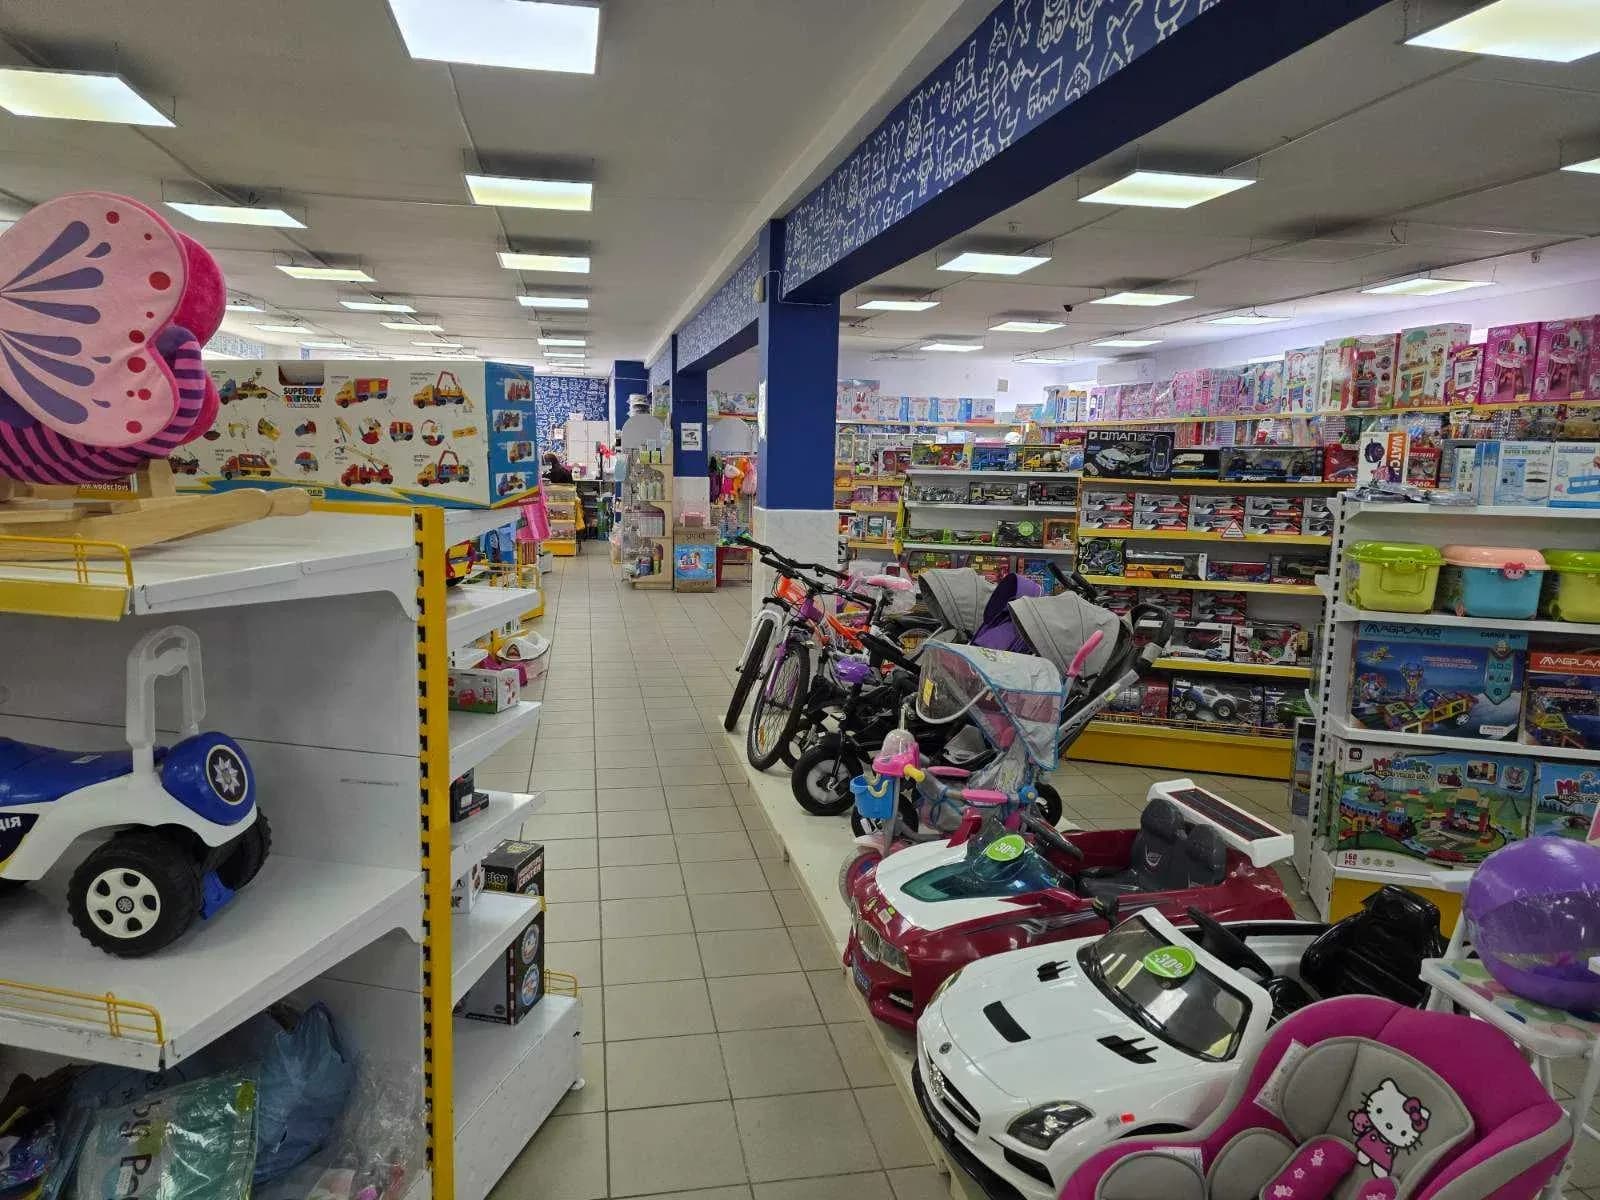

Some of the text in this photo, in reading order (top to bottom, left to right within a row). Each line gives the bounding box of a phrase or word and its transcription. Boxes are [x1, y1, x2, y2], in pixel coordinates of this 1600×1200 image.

[283, 387, 308, 395] SUPER
[1364, 623, 1441, 641] MAGPLAYER
[1539, 656, 1600, 669] MAGPLAY
